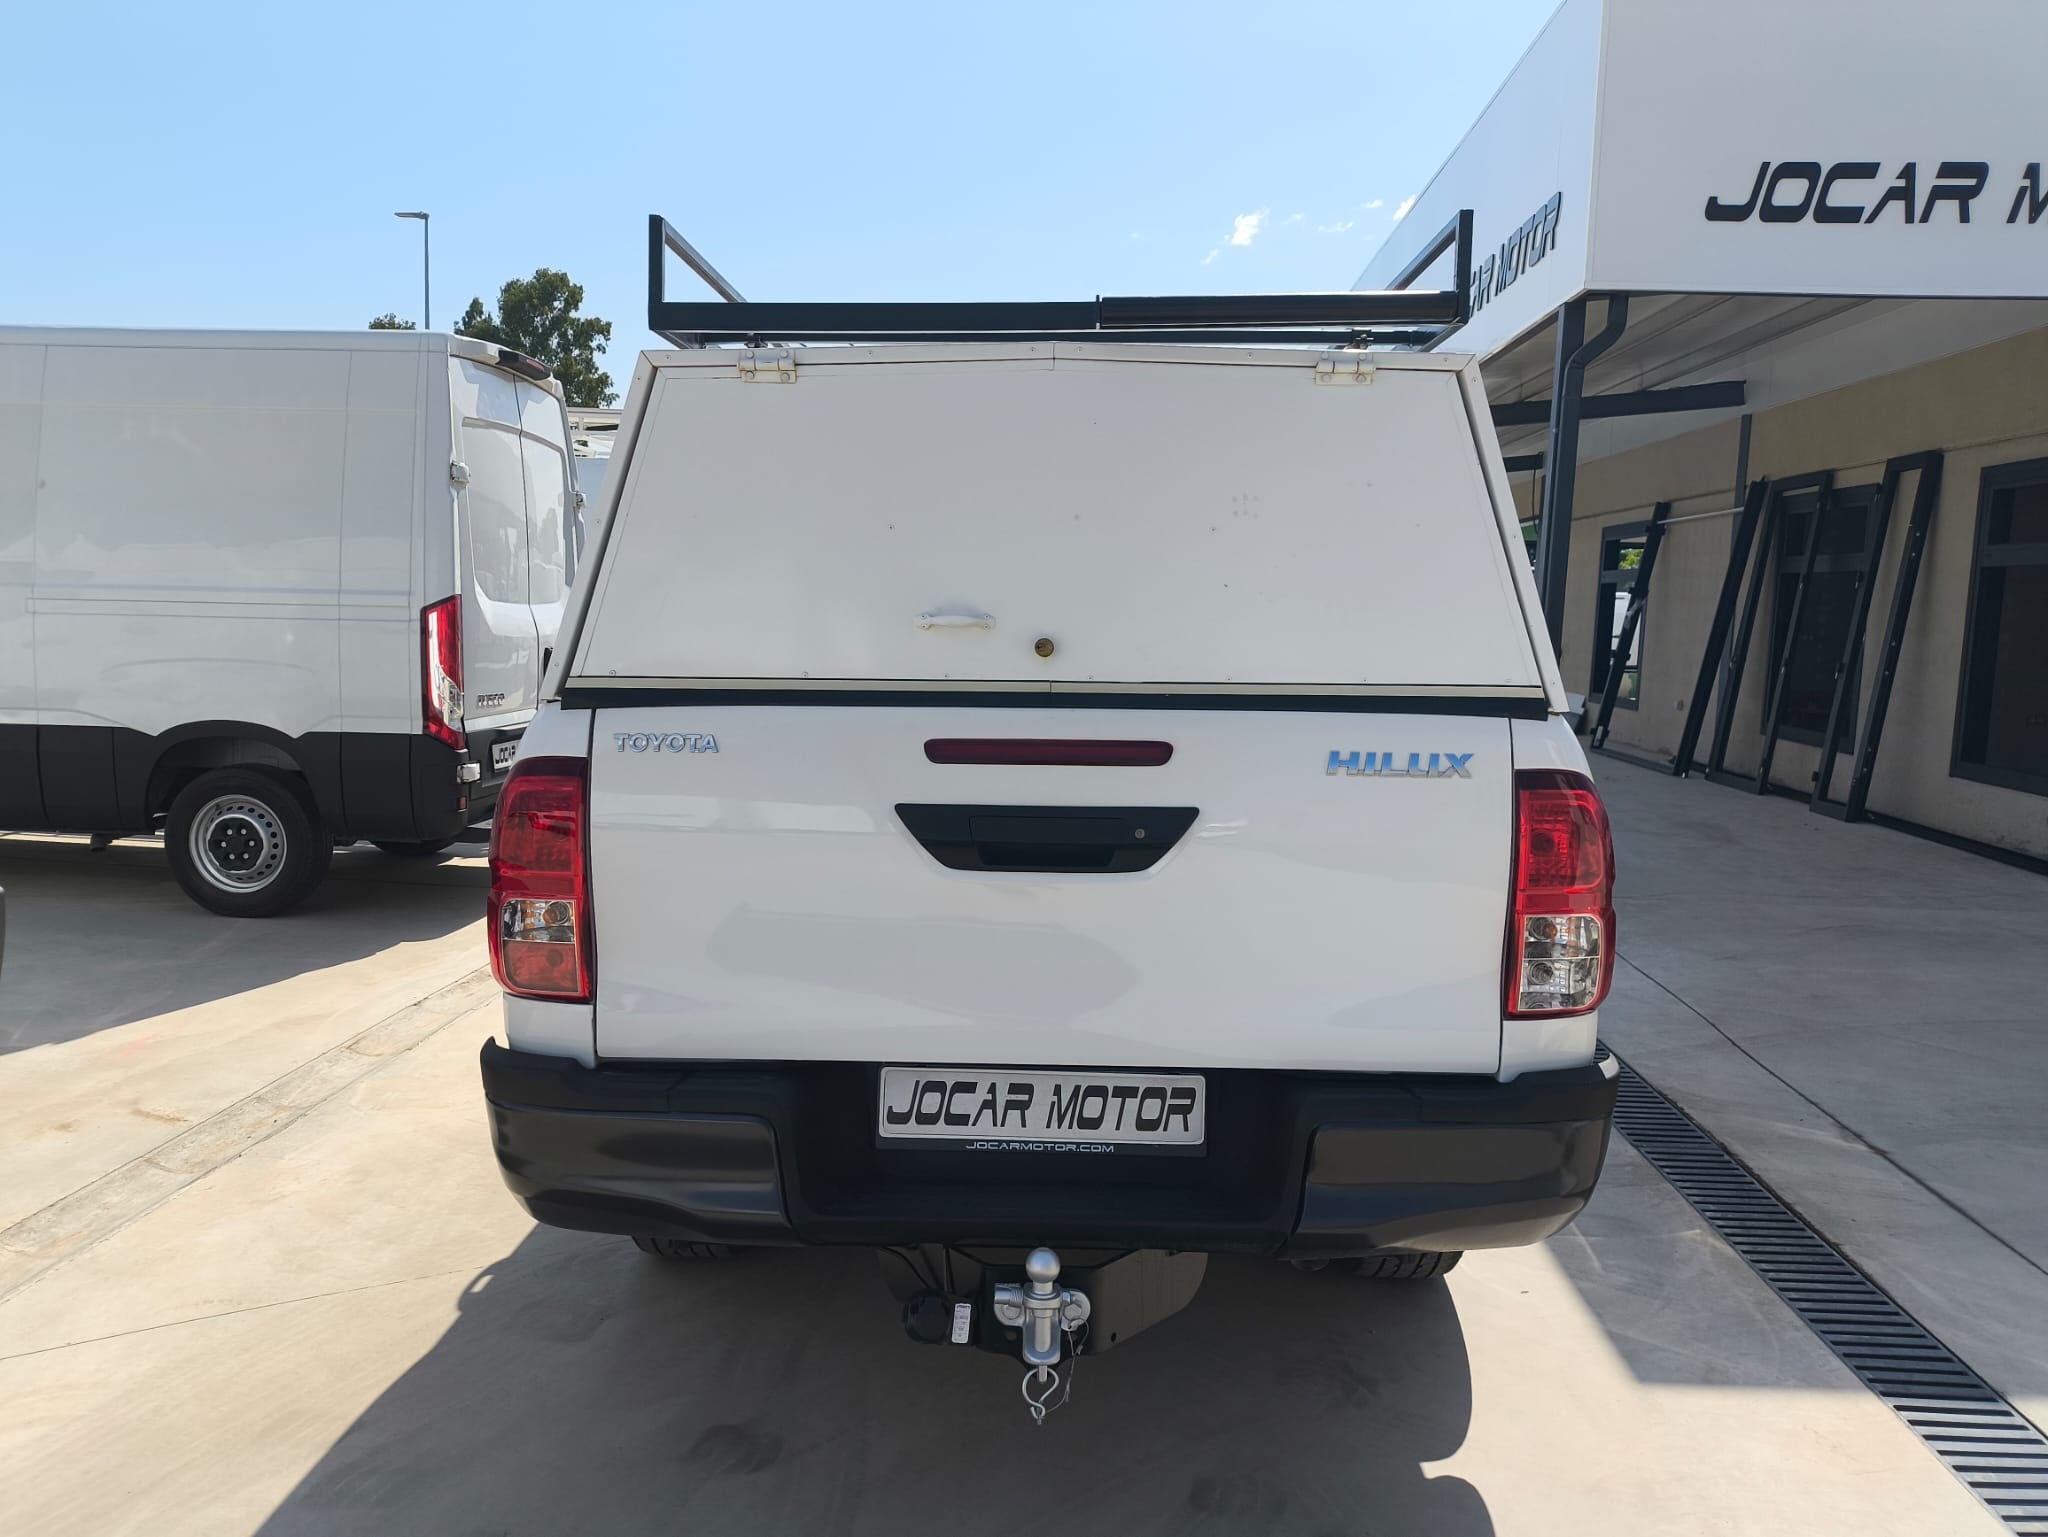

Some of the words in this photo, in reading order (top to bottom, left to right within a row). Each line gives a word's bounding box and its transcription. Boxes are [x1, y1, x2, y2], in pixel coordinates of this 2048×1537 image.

[1704, 161, 1990, 224] JOCAR
[1494, 191, 1562, 297] MOTOR
[613, 732, 719, 753] TOYOTA
[1326, 750, 1475, 779] HILUX
[886, 1079, 1034, 1128] JOCAR
[1045, 1083, 1197, 1132] MOTOR
[965, 1140, 1115, 1153] JOCARMOTOR.COM
